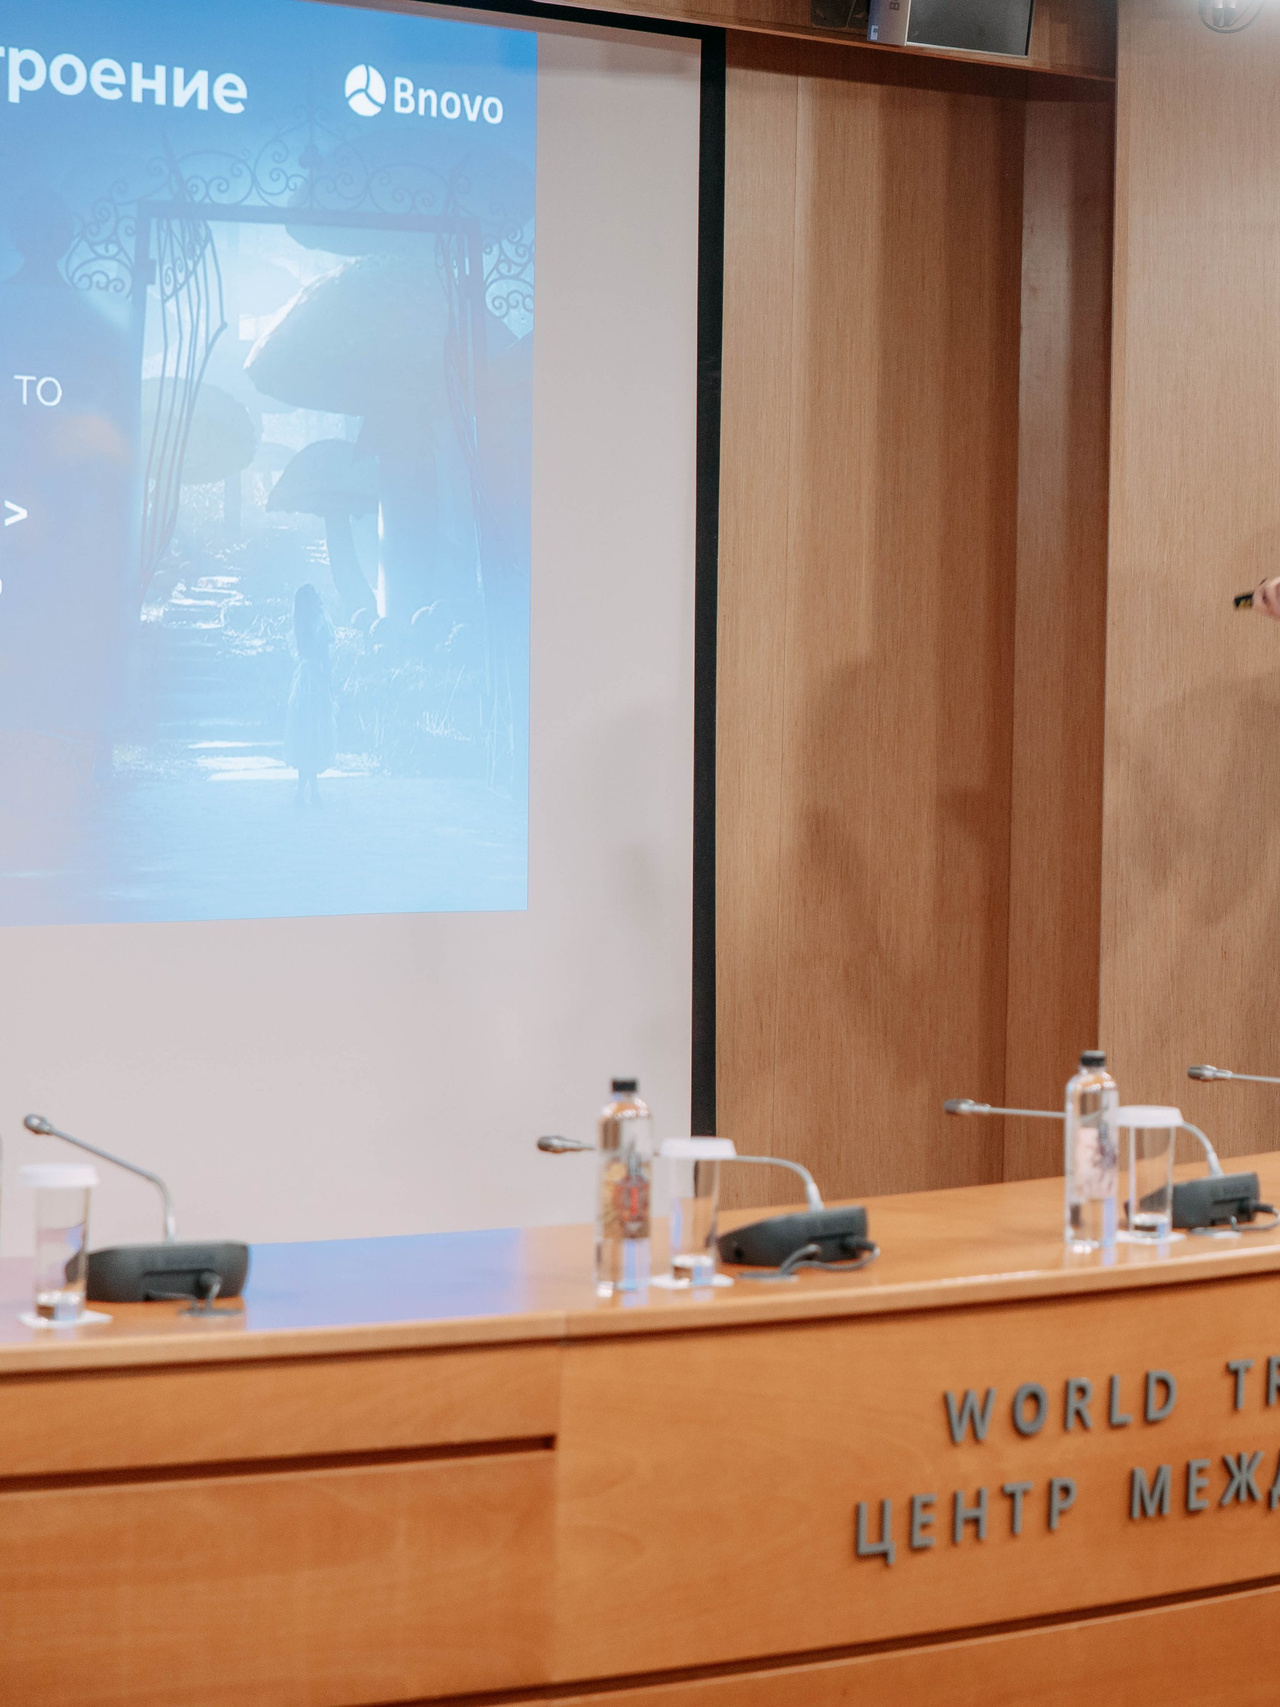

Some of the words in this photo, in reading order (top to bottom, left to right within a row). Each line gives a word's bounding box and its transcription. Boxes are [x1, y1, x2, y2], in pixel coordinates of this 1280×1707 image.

[0, 46, 248, 115] роение
[394, 76, 504, 125] Bnovo
[944, 1368, 1178, 1445] WORLD
[855, 1476, 1078, 1565] ЦЕНТР
